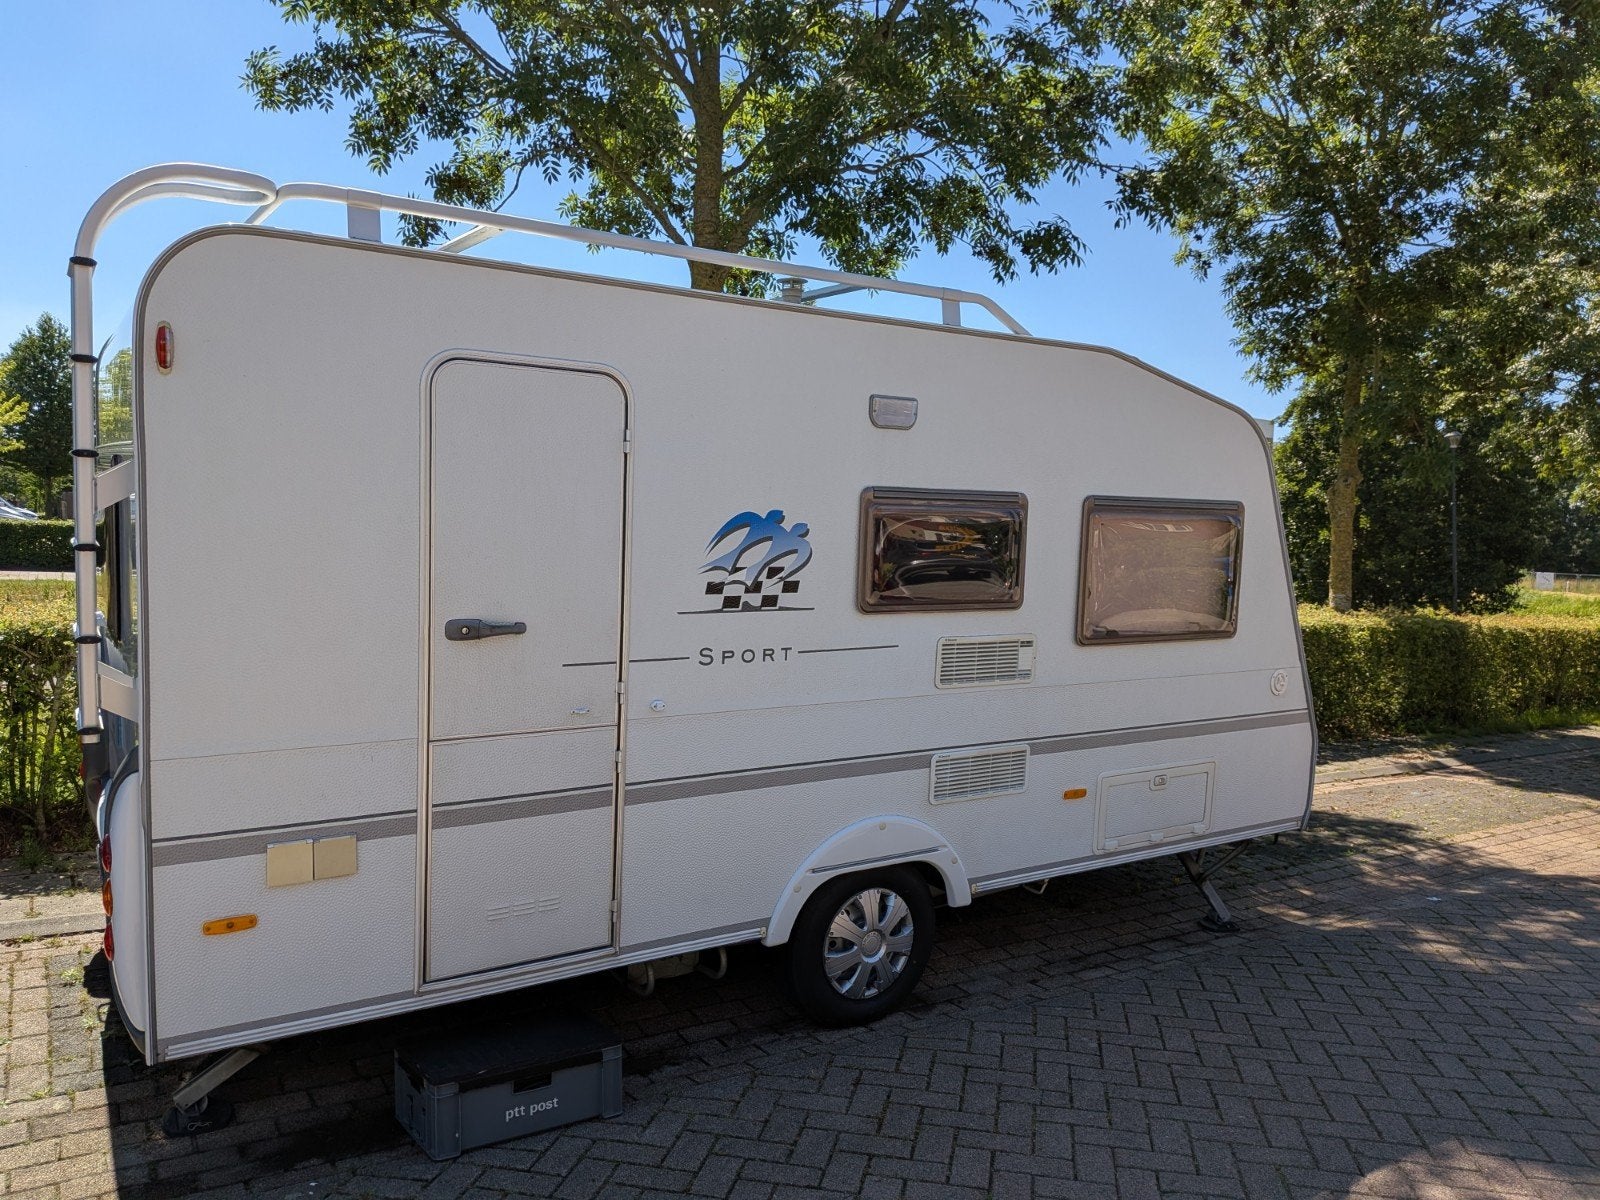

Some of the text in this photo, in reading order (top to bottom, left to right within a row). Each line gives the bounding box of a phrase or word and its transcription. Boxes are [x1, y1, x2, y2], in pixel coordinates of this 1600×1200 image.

[698, 647, 793, 666] SPORT
[505, 1097, 559, 1122] ptt post
